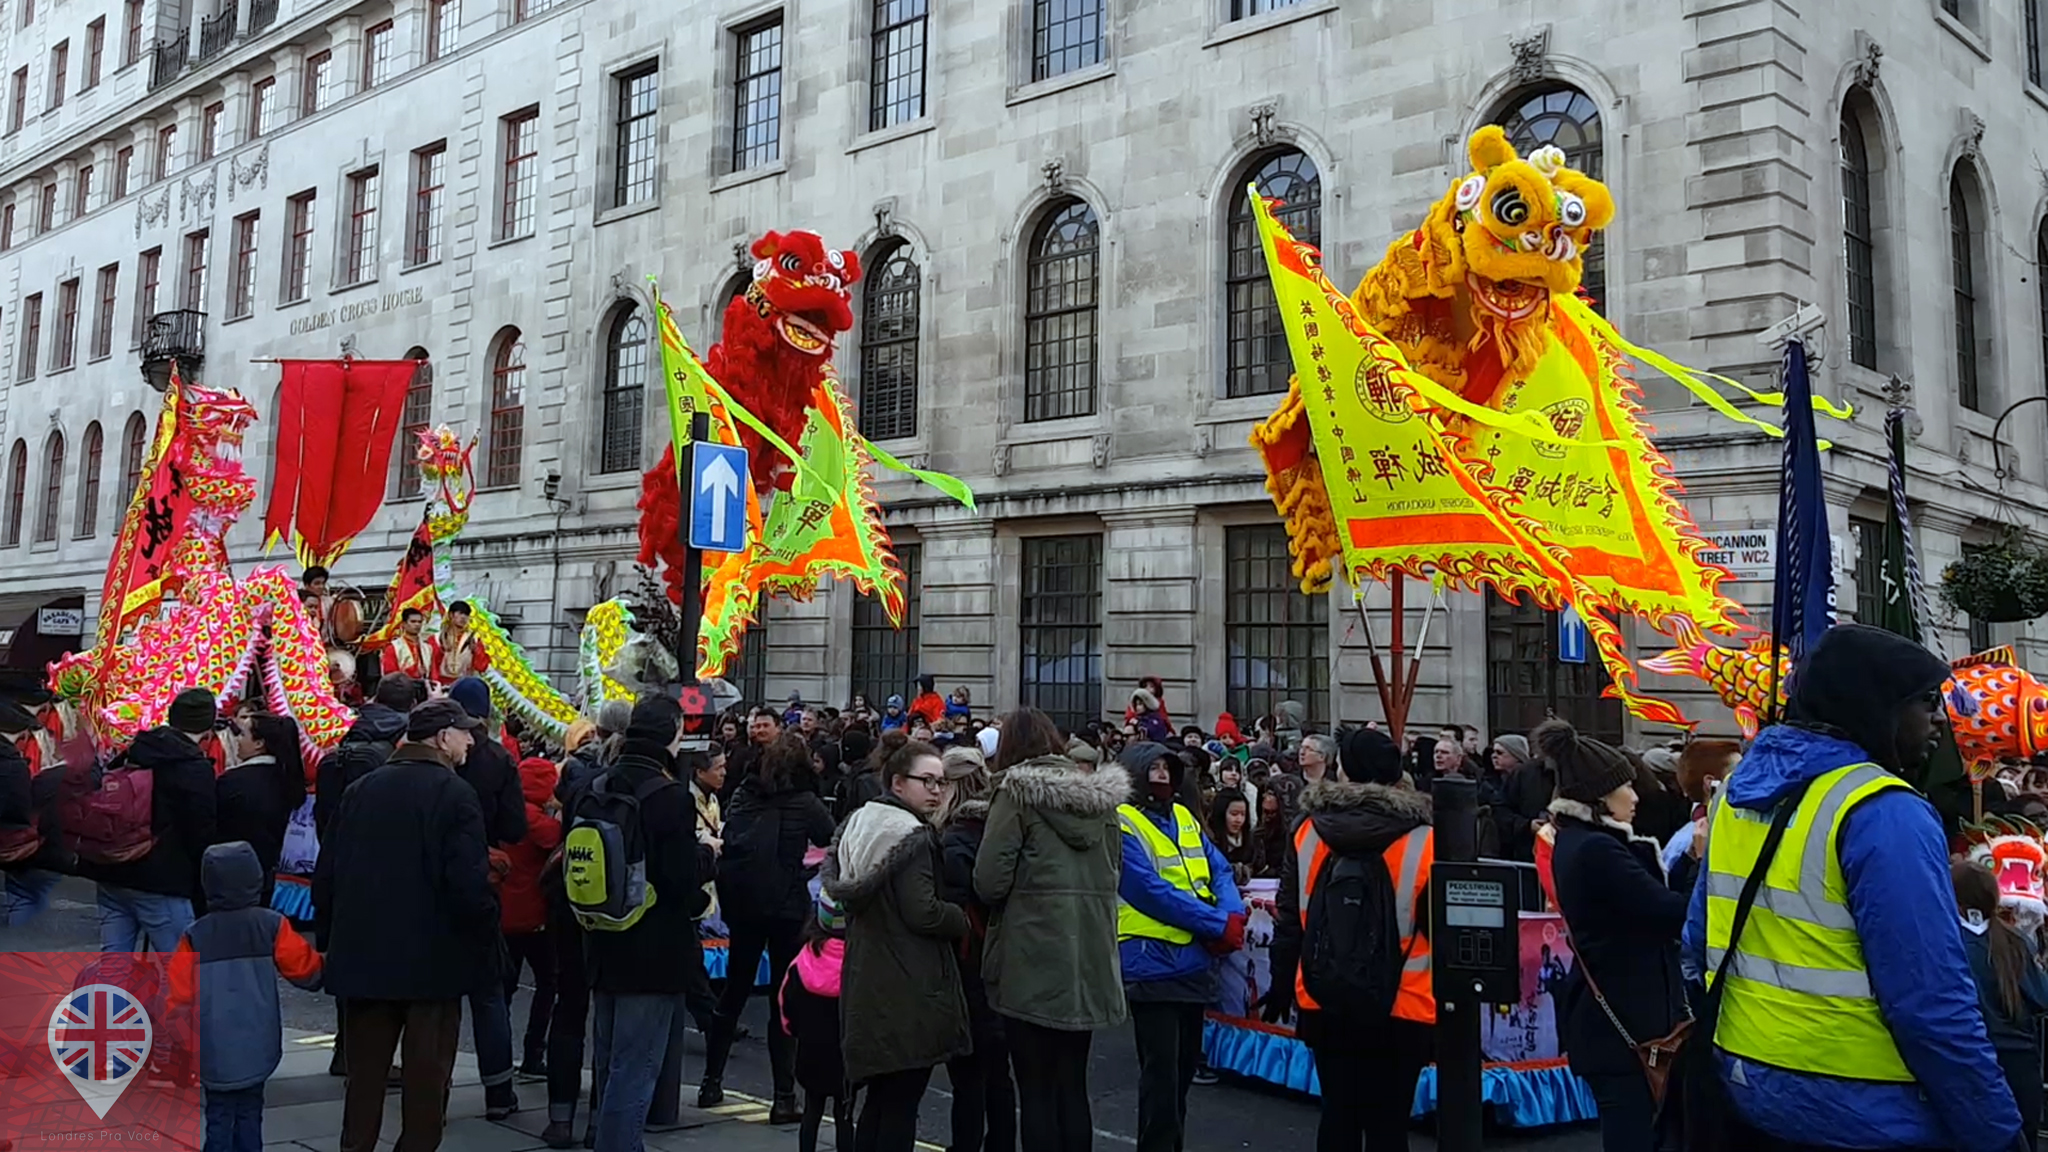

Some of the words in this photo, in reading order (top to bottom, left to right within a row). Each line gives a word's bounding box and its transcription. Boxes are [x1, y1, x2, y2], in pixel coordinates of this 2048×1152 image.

[290, 310, 336, 336] GOLDEN
[340, 298, 378, 323] CROSS
[382, 286, 423, 312] HOUSE
[1695, 551, 1735, 564] TREET
[1741, 550, 1770, 564] WC2
[1449, 882, 1500, 892] PEDESTRIANS
